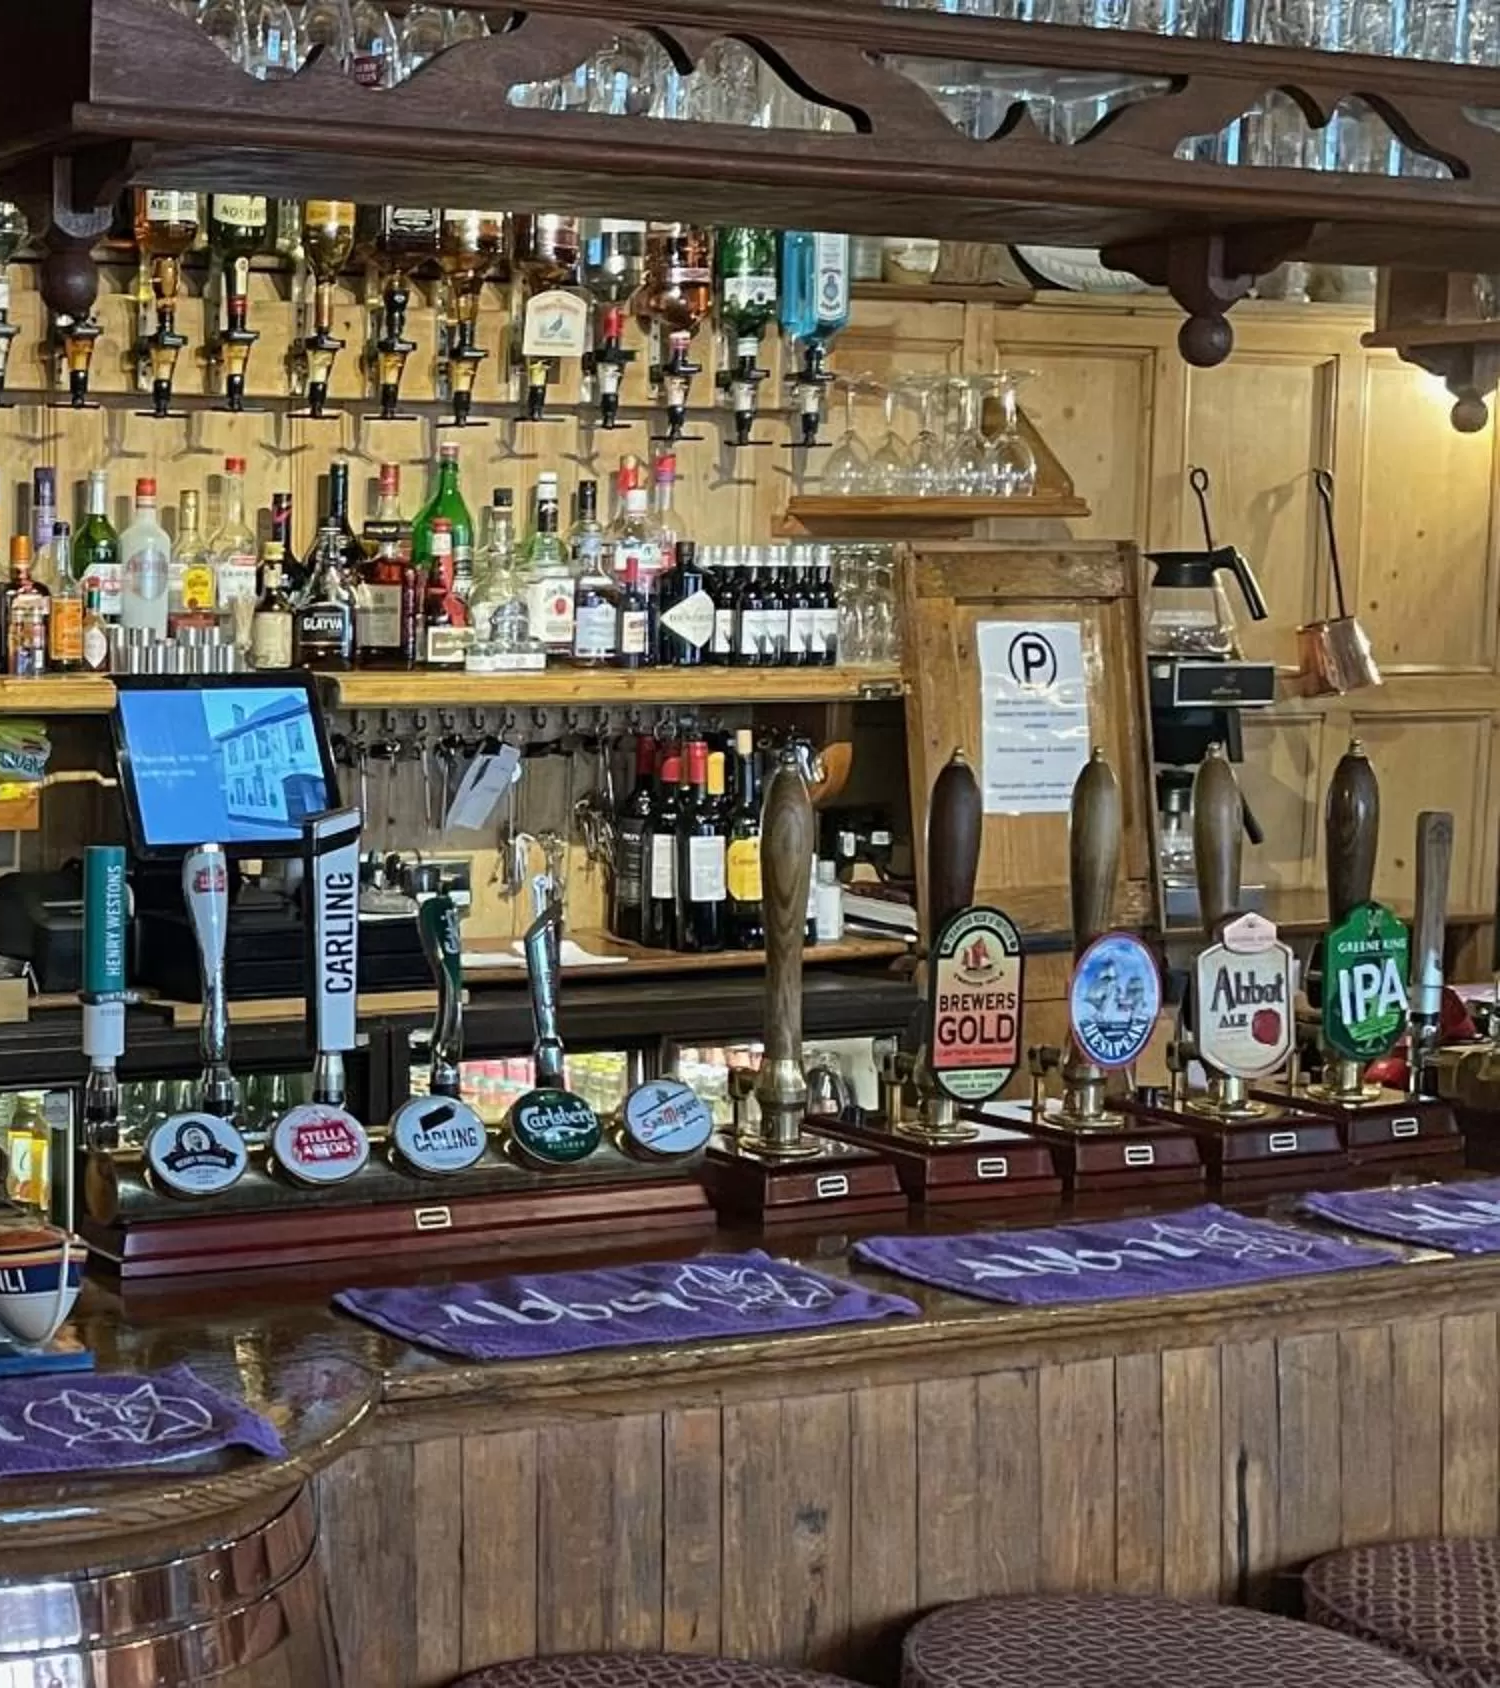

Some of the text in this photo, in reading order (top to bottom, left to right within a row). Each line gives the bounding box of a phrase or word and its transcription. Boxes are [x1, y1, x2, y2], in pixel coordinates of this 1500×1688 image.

[303, 617, 343, 631] GLAYVA
[1021, 642, 1047, 686] P
[105, 865, 122, 977] HENRY WESTONS
[325, 873, 354, 995] CARLING
[1338, 940, 1381, 953] GREENE
[940, 992, 1016, 1014] BREWERS
[1211, 965, 1283, 1012] Abbot
[1339, 957, 1409, 1026] IPA
[938, 1014, 1015, 1046] GOLD
[1220, 1014, 1248, 1028] ALE
[521, 1102, 597, 1134] Carlsberg
[300, 1127, 348, 1144] STELLA
[413, 1128, 478, 1151] CARLING
